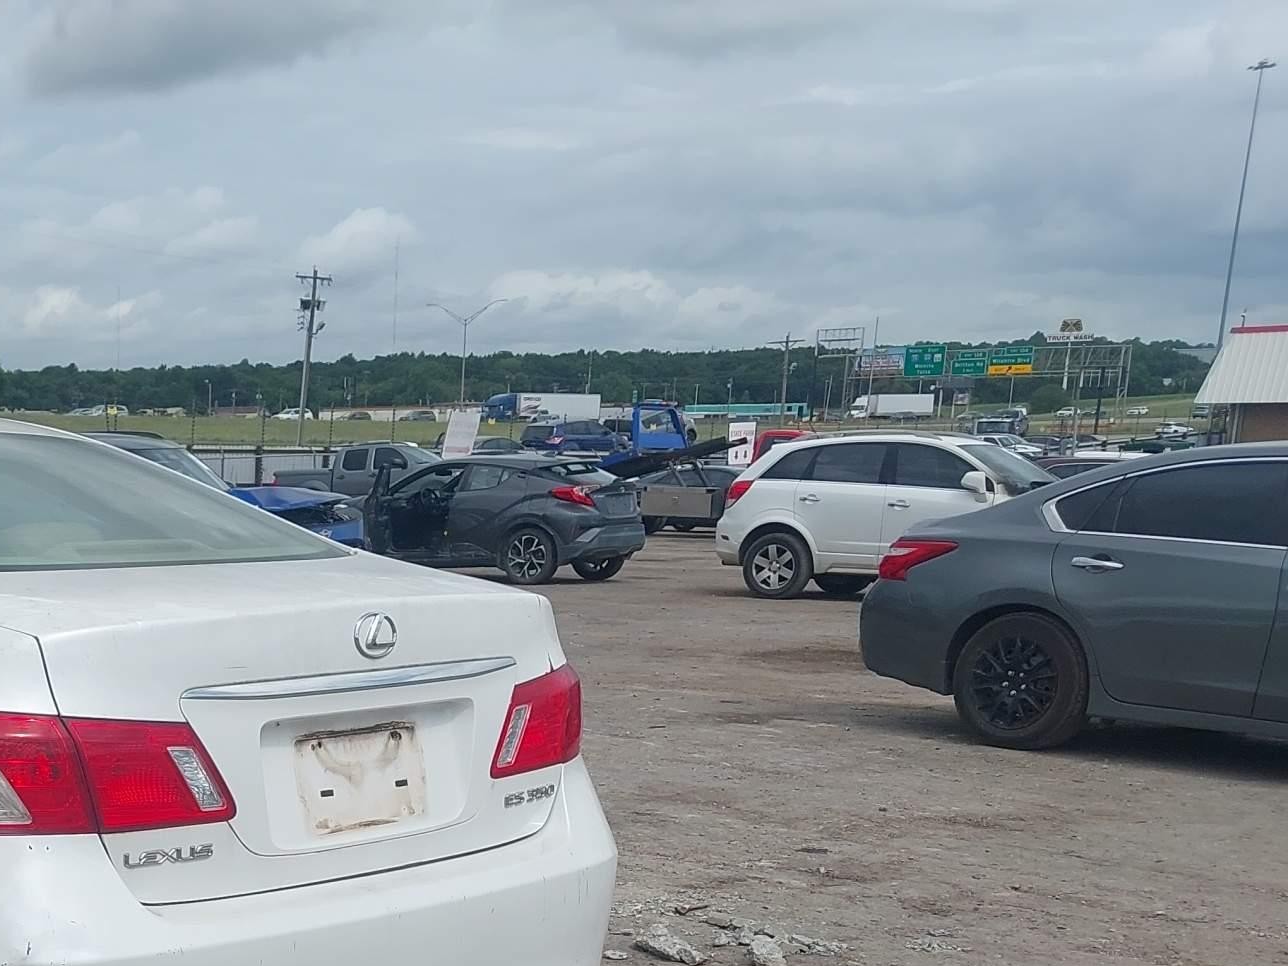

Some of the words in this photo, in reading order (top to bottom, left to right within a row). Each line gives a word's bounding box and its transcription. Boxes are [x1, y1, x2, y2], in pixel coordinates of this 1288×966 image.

[503, 791, 525, 808] ES
[526, 784, 555, 803] 350
[122, 843, 214, 869] LEXUS
